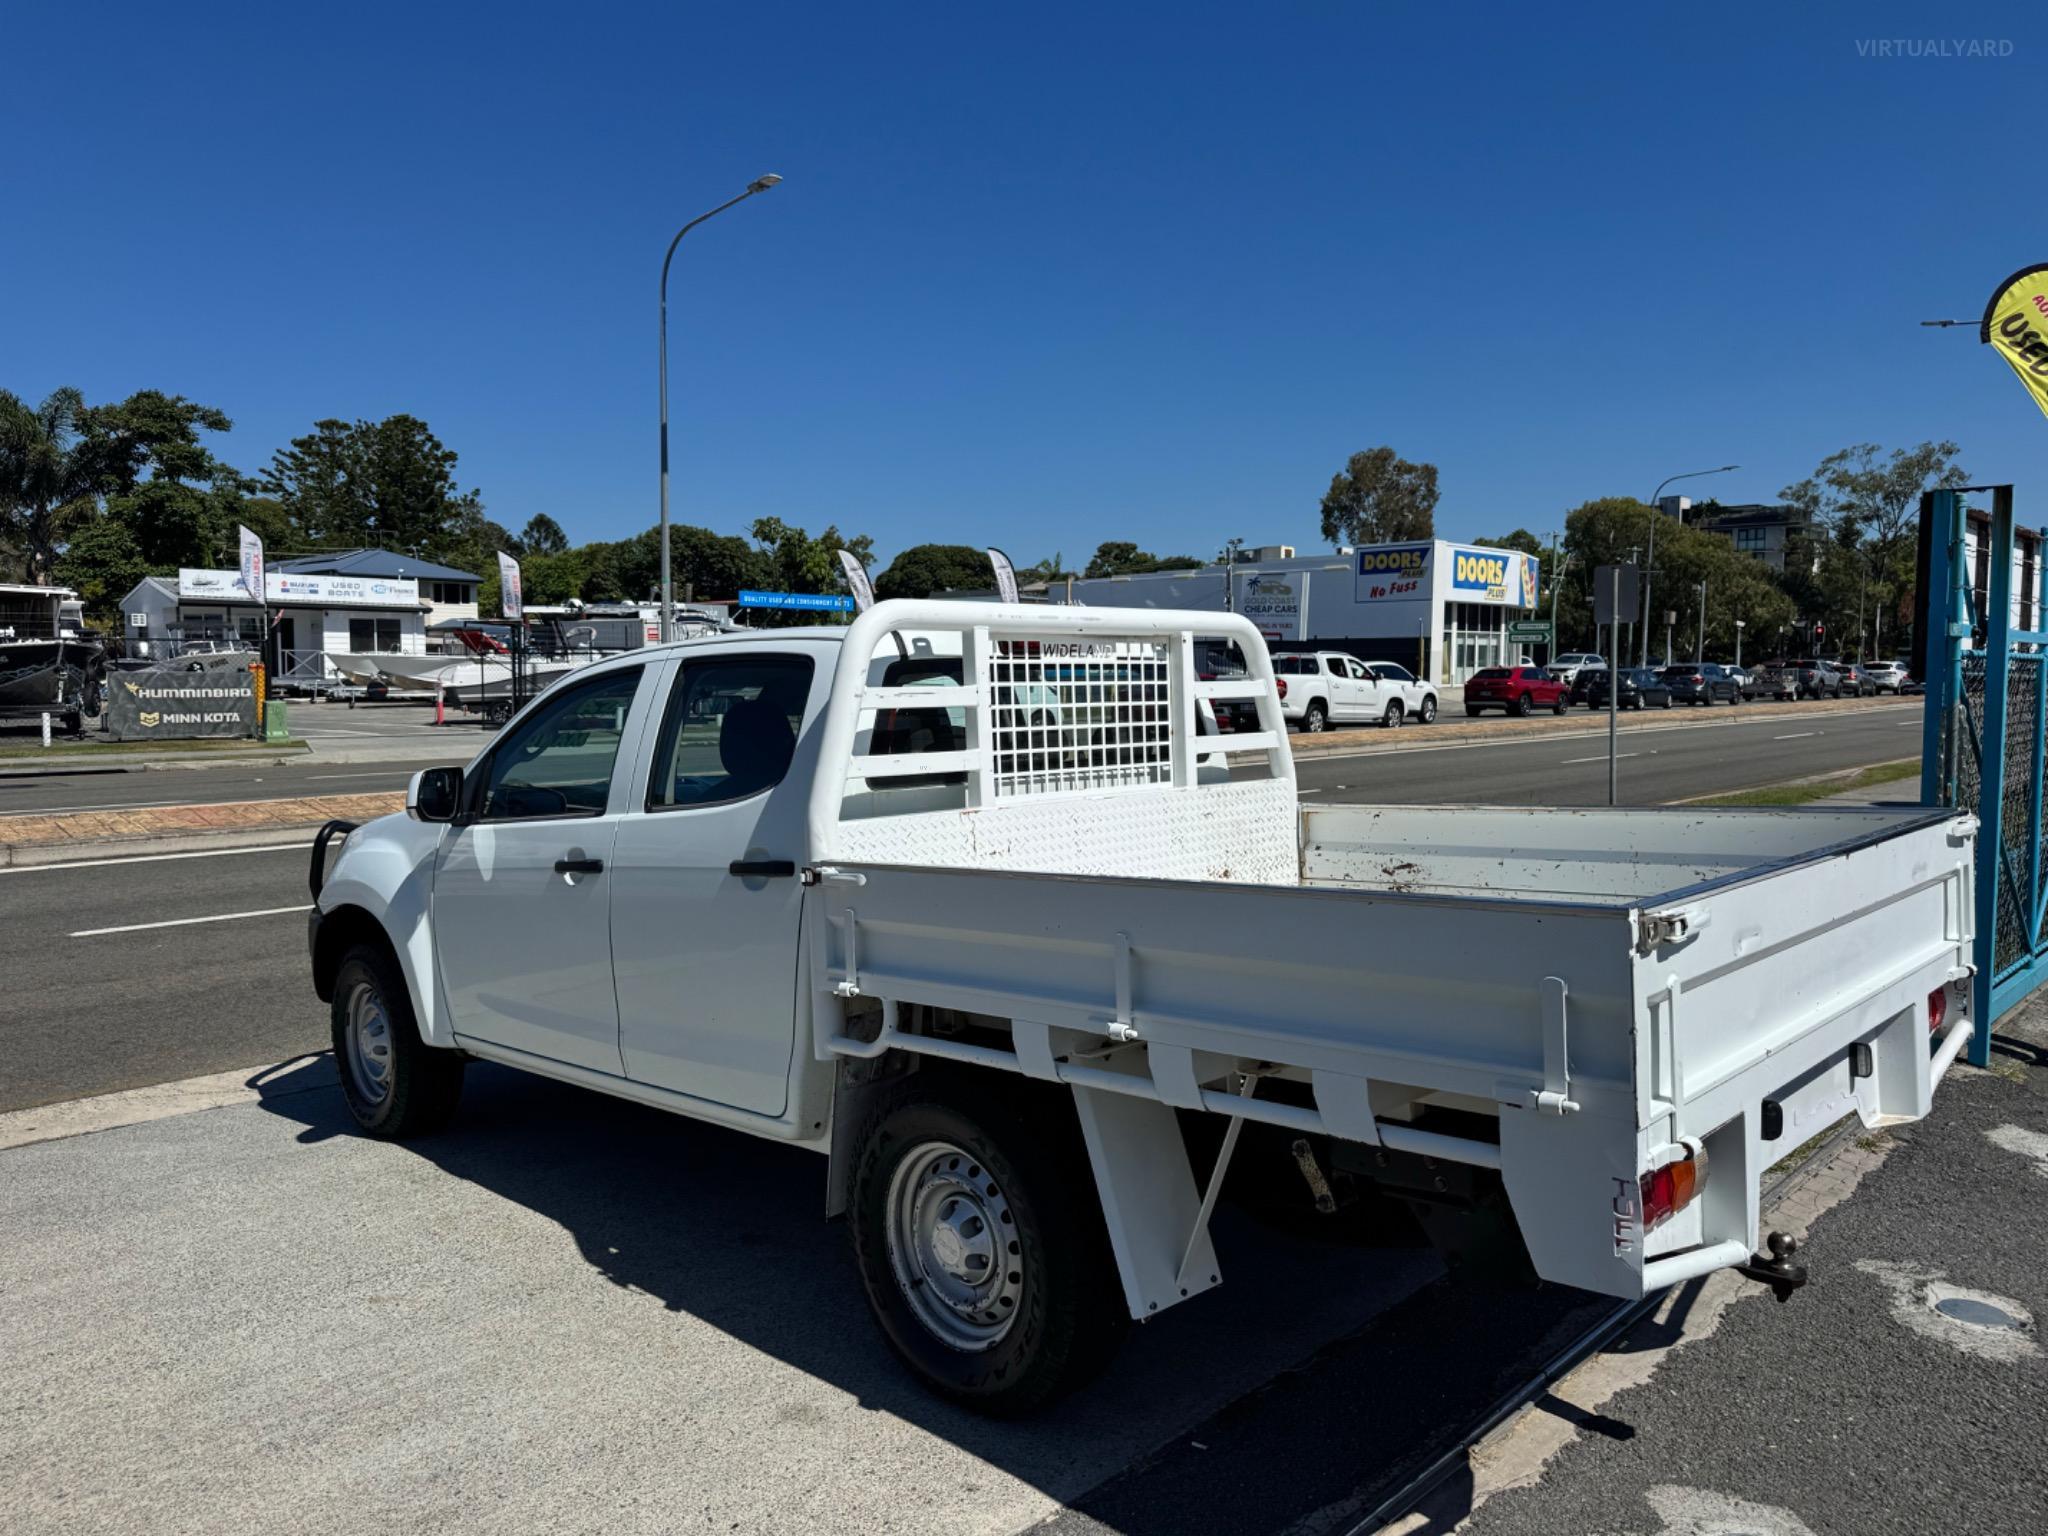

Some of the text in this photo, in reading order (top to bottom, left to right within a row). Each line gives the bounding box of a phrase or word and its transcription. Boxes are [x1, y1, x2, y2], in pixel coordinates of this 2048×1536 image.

[1364, 551, 1421, 570] DOORS
[1400, 568, 1425, 579] PLUS
[1457, 555, 1503, 585] DOORS
[331, 582, 361, 590] USED
[1370, 580, 1417, 598] No Fuss
[328, 589, 365, 597] BOATS
[1486, 587, 1504, 598] PLUS
[744, 595, 767, 603] QUALITY
[1244, 605, 1297, 613] CHEAP CARS
[138, 688, 251, 699] HUMMINBIRD
[163, 712, 241, 724] MINN KOTA
